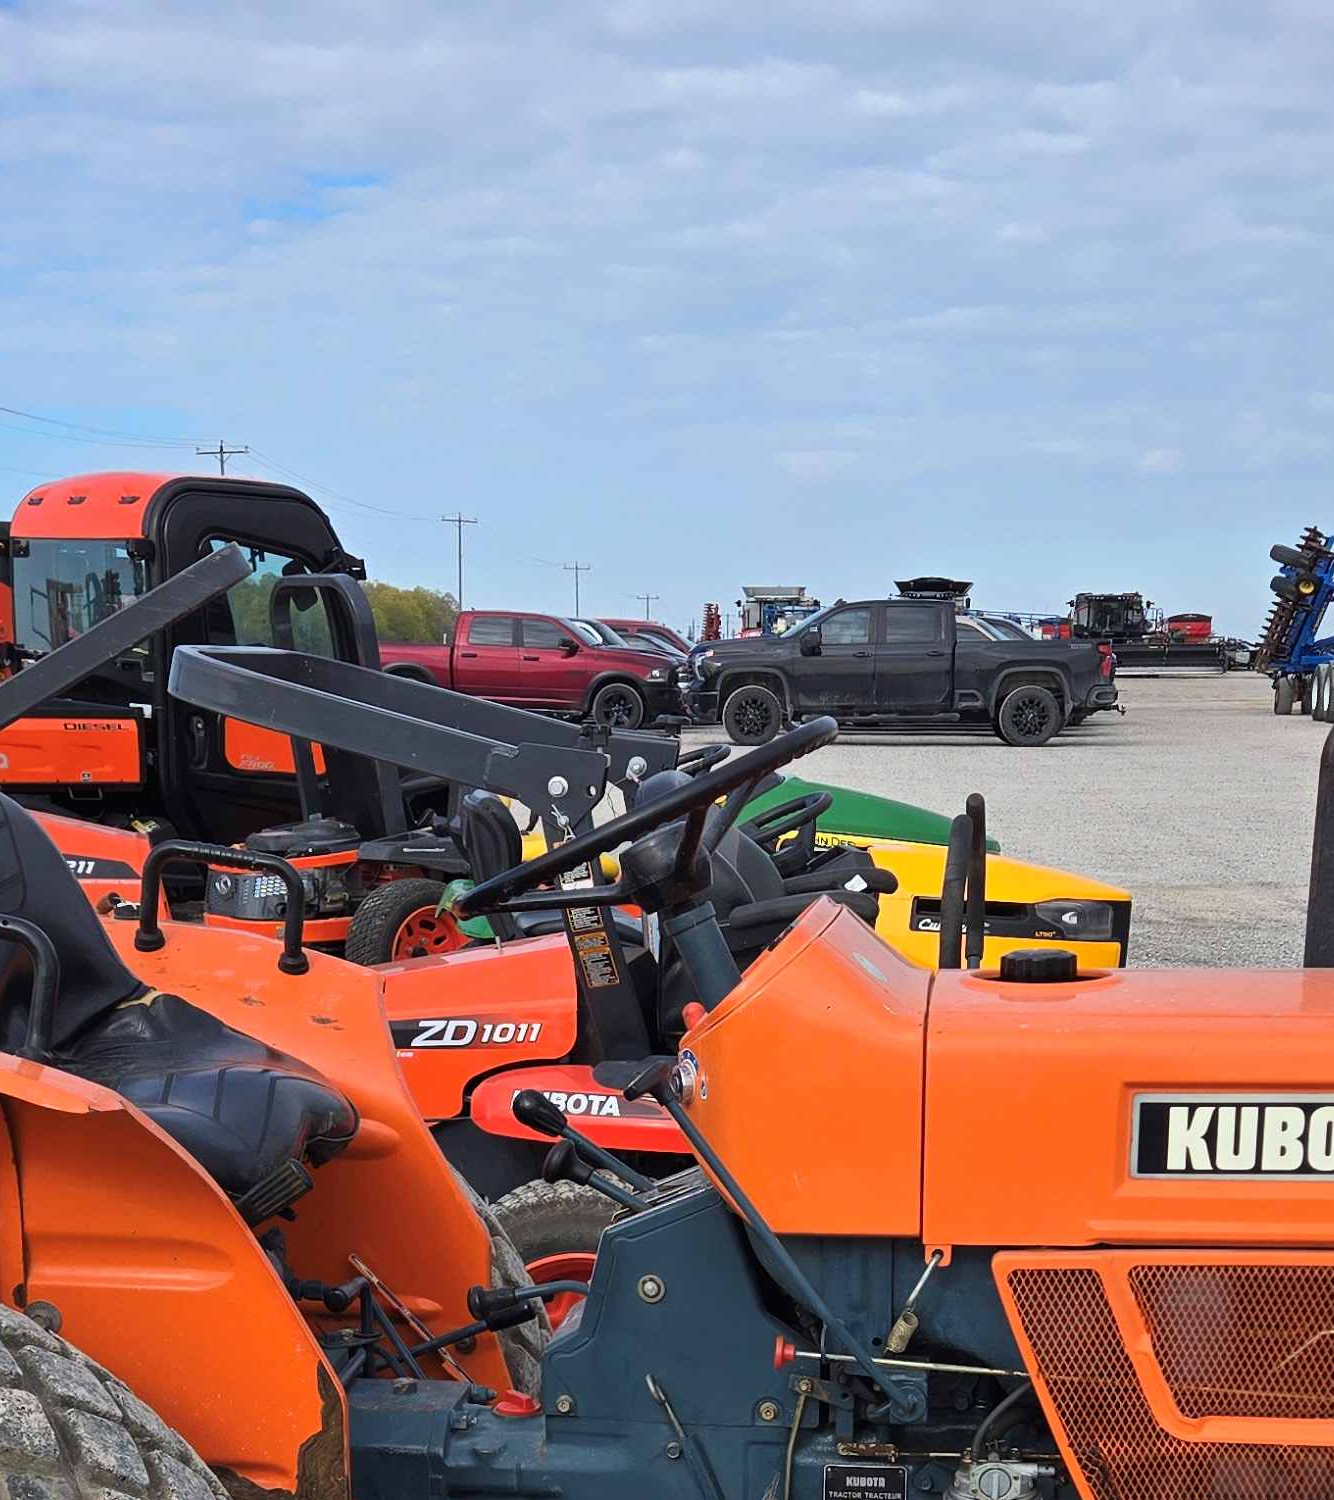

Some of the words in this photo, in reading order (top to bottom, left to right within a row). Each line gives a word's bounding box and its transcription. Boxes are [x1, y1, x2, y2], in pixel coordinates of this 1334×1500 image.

[63, 723, 129, 731] DIESEL
[845, 1476, 886, 1488] KUBOTA
[828, 1491, 862, 1499] TRACTOR
[865, 1492, 902, 1500] TRACTEUR
